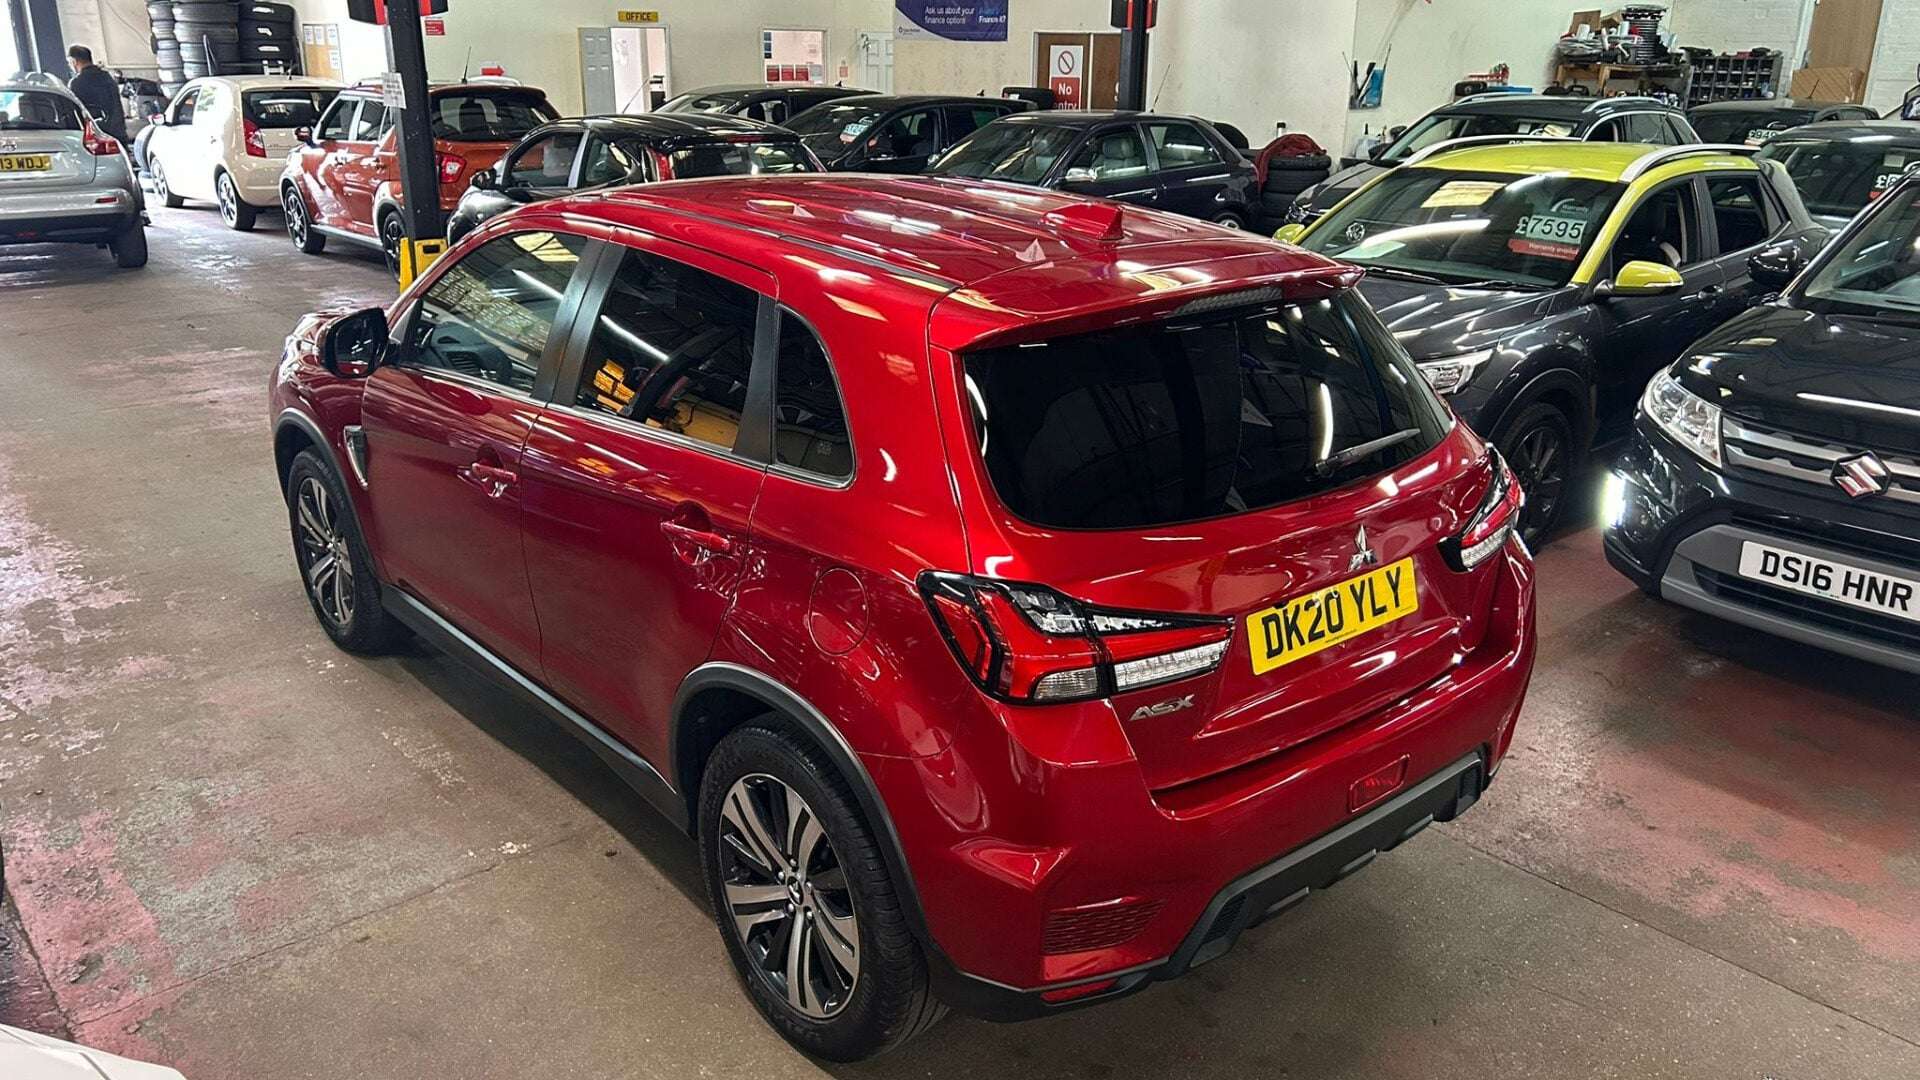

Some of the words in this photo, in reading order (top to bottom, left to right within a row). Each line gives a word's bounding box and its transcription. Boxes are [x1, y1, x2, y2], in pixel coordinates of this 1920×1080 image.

[625, 12, 652, 21] OFFICE
[925, 6, 934, 14] Ask
[945, 6, 961, 14] about
[961, 7, 975, 16] your
[925, 16, 945, 24] finance
[1058, 83, 1072, 95] No
[16, 156, 44, 168] WDJ
[1515, 216, 1583, 239] £7595
[1760, 550, 1833, 591] DS16
[1841, 571, 1912, 611] HNR
[1261, 590, 1344, 659] DK20
[1350, 566, 1401, 622] YLY
[1128, 694, 1195, 721] ASX
